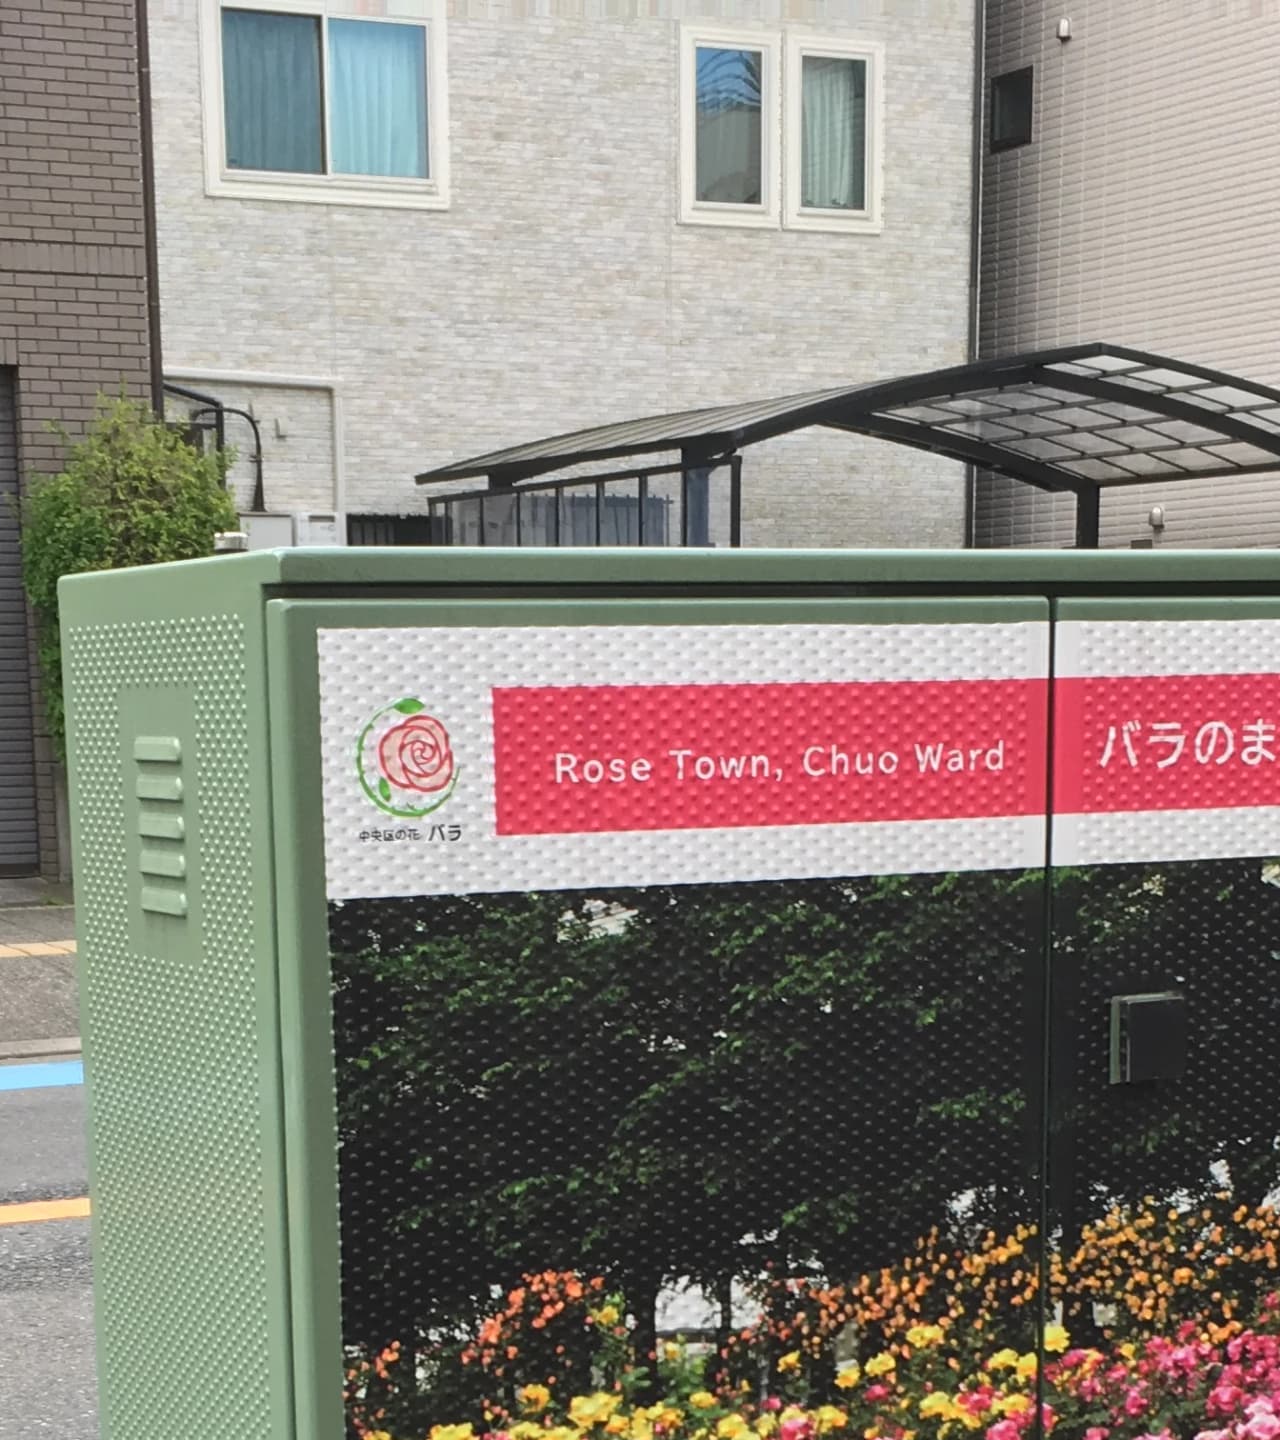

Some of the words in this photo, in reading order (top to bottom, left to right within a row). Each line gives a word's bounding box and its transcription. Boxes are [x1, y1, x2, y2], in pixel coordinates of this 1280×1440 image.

[554, 752, 652, 784] Rose
[669, 749, 785, 784] Town,
[802, 745, 900, 778] Chuo
[914, 740, 1006, 773] Ward
[428, 824, 462, 842] バラ
